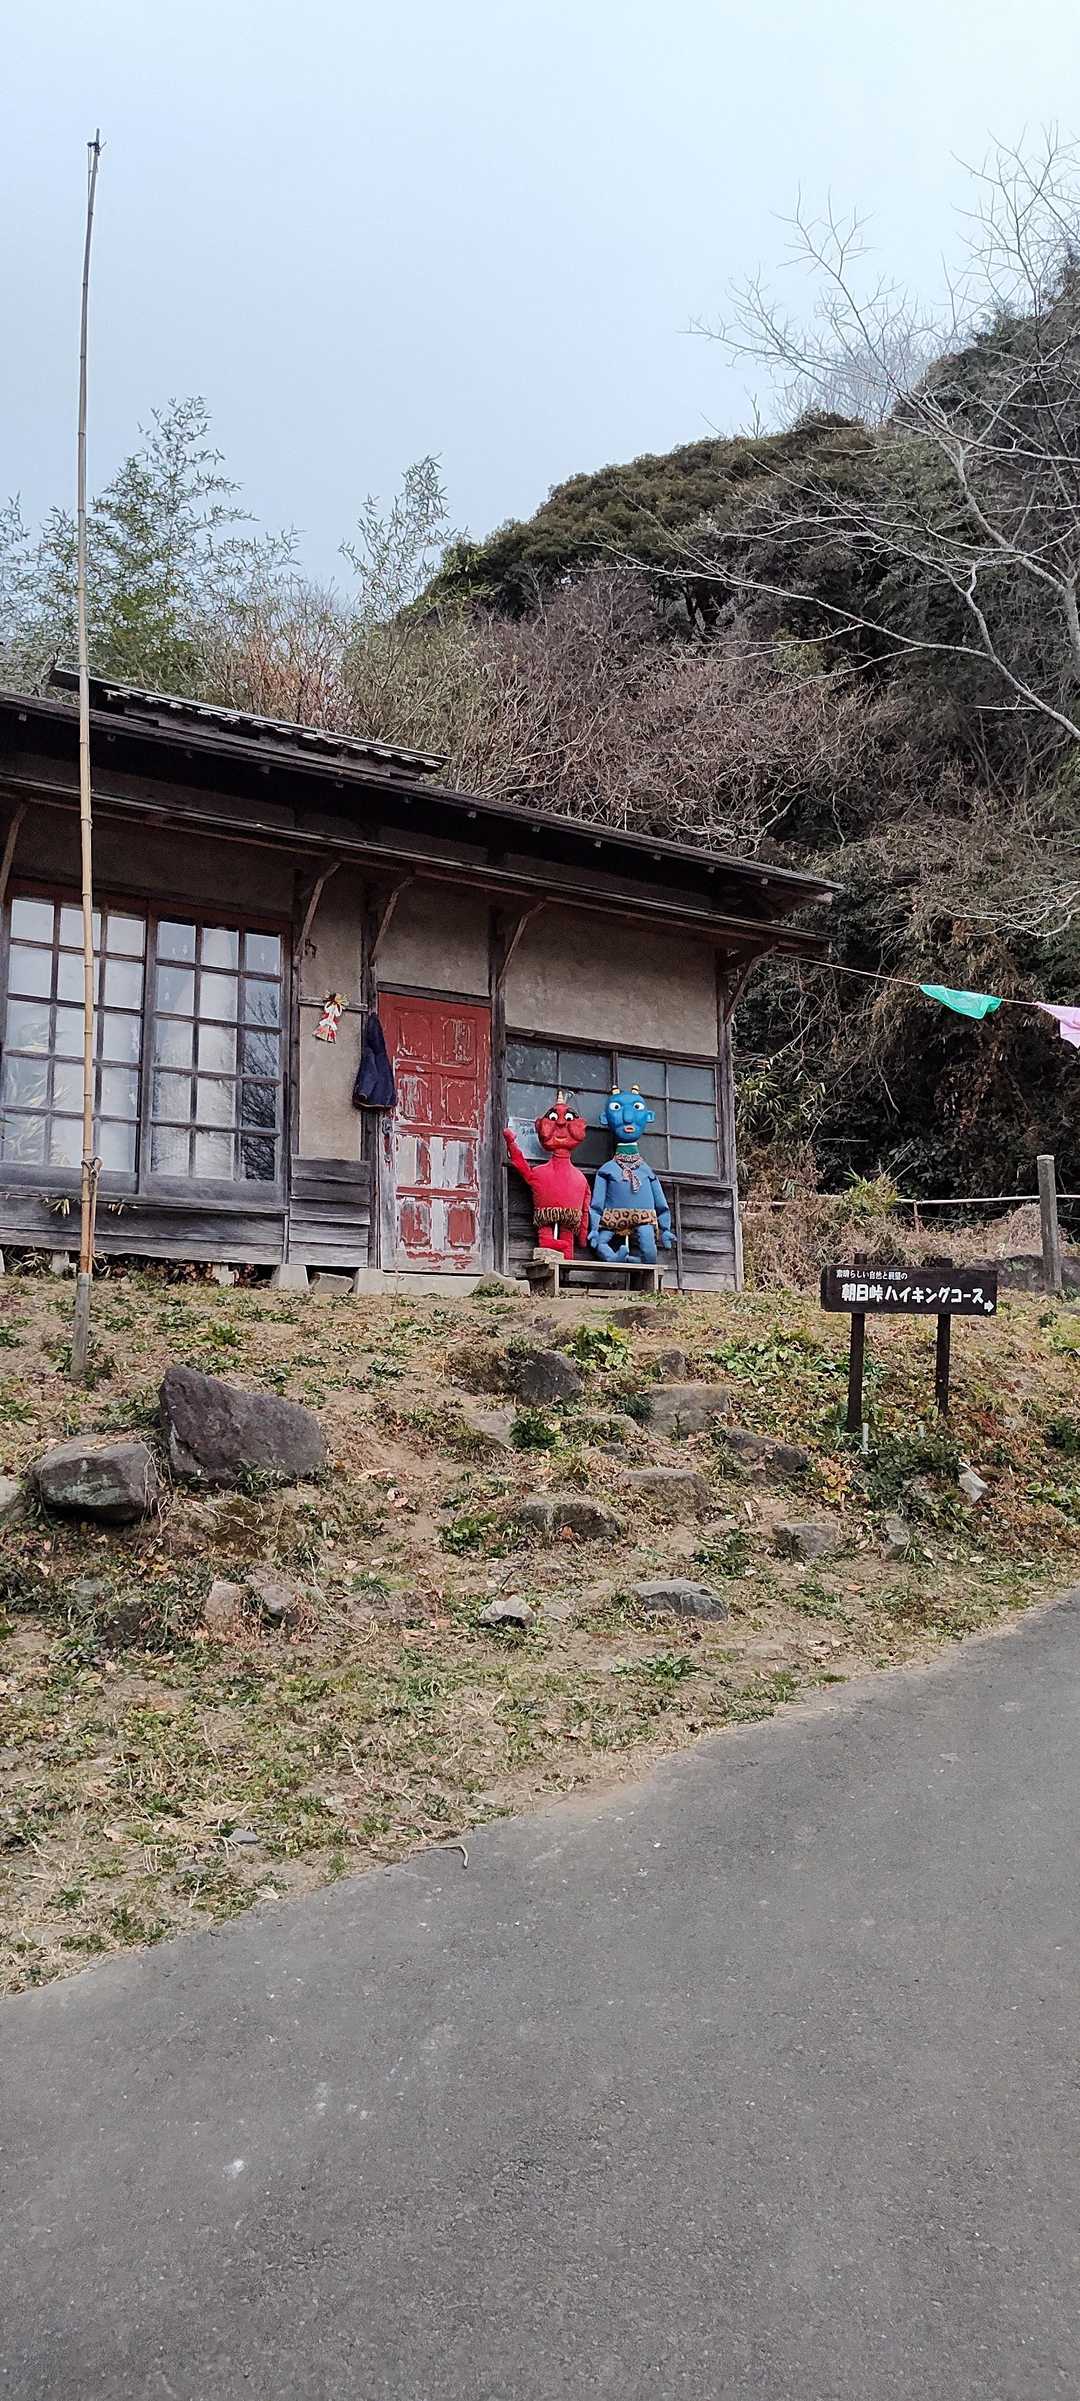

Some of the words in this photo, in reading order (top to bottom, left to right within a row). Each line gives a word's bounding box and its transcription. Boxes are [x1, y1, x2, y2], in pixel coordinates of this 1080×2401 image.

[841, 1283, 984, 1304] 朝日峠ハイキングコース
